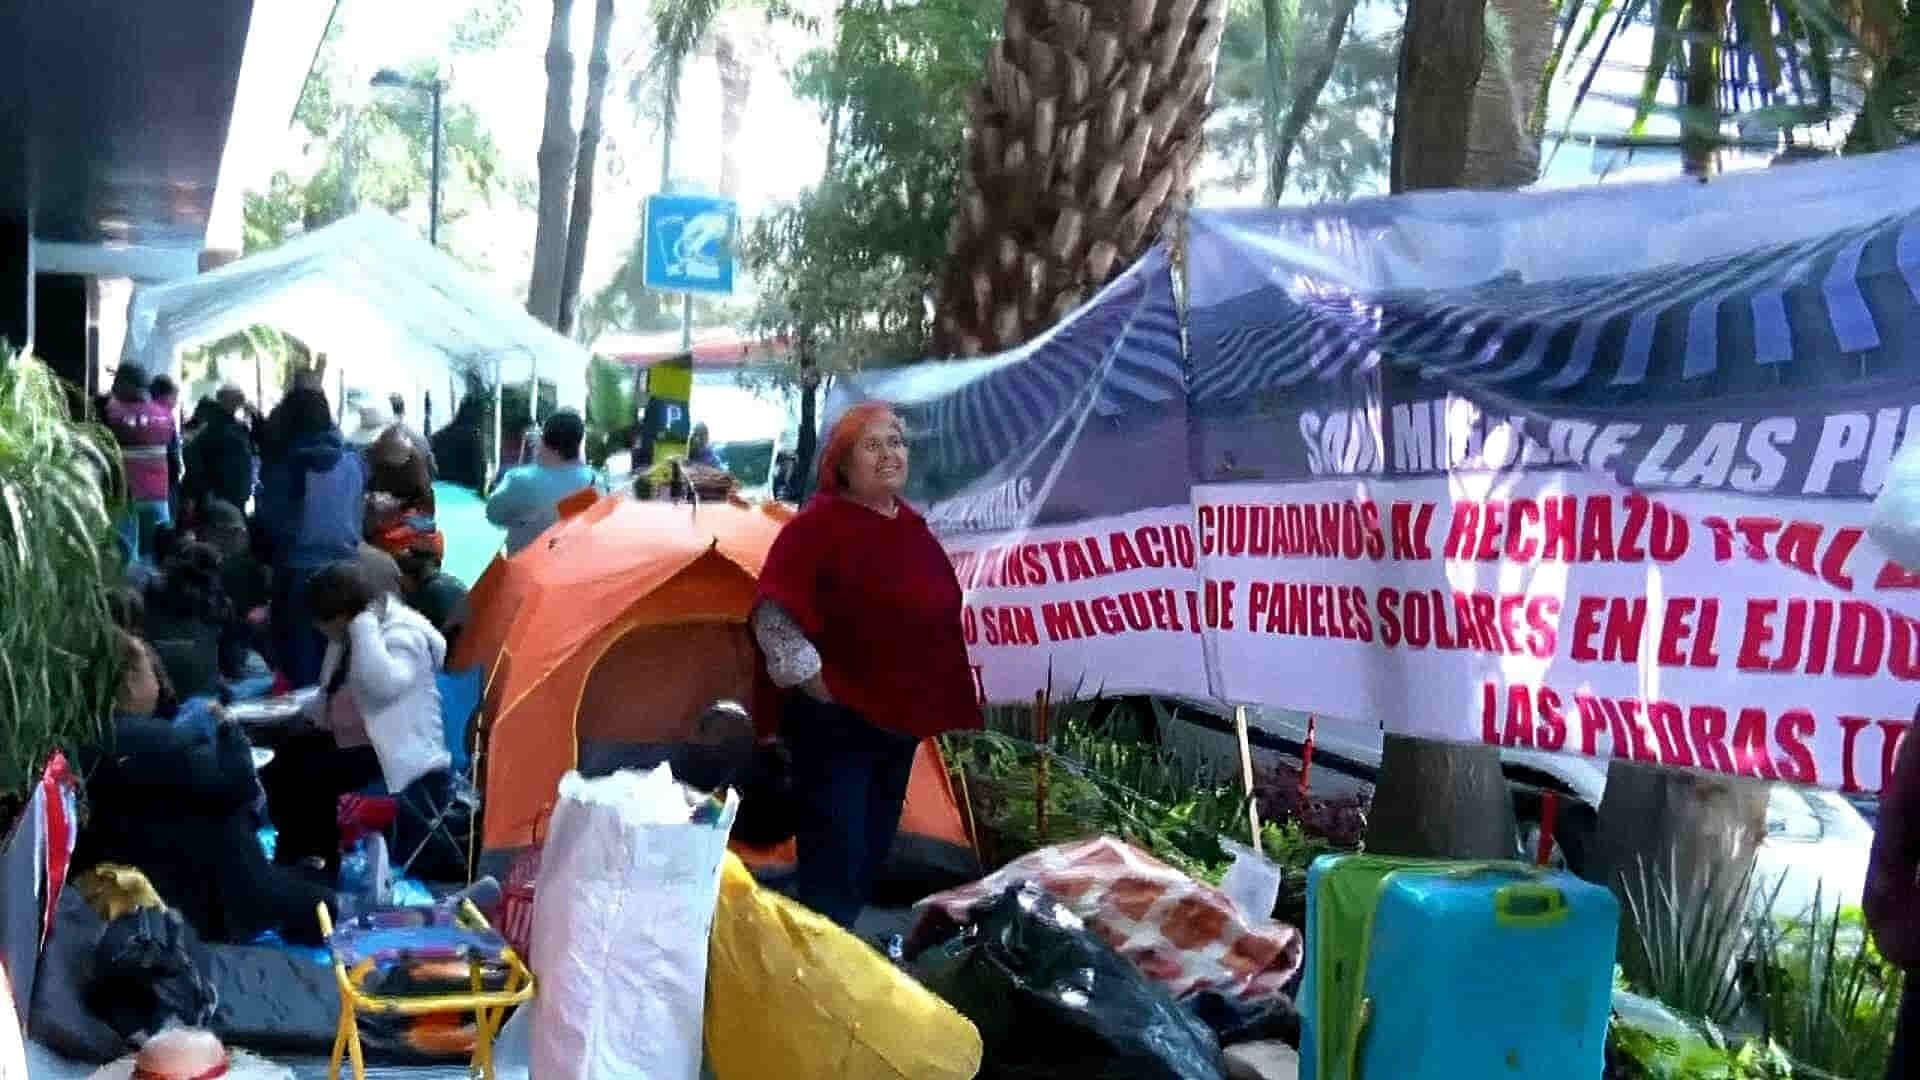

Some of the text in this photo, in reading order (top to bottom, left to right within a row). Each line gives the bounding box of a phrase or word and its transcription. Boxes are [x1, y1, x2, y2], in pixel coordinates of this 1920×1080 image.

[1633, 415, 1797, 493] LAS
[1199, 500, 1385, 562] CIUDADANOS
[1391, 501, 1438, 561] AL
[1443, 494, 1690, 564] RECHAZO
[1702, 515, 1865, 591] TTAL
[981, 605, 1040, 646] SAN
[1041, 588, 1185, 642] MIGUEL
[1204, 579, 1236, 630] DE
[1249, 579, 1374, 642] PANELES
[1377, 586, 1559, 660] SOLARES
[1571, 597, 1647, 664] EN
[1657, 597, 1720, 668] EL
[1736, 598, 1920, 681] EJIDO
[1481, 682, 1568, 751] LAS
[1574, 690, 1819, 785] PIEDRAS
